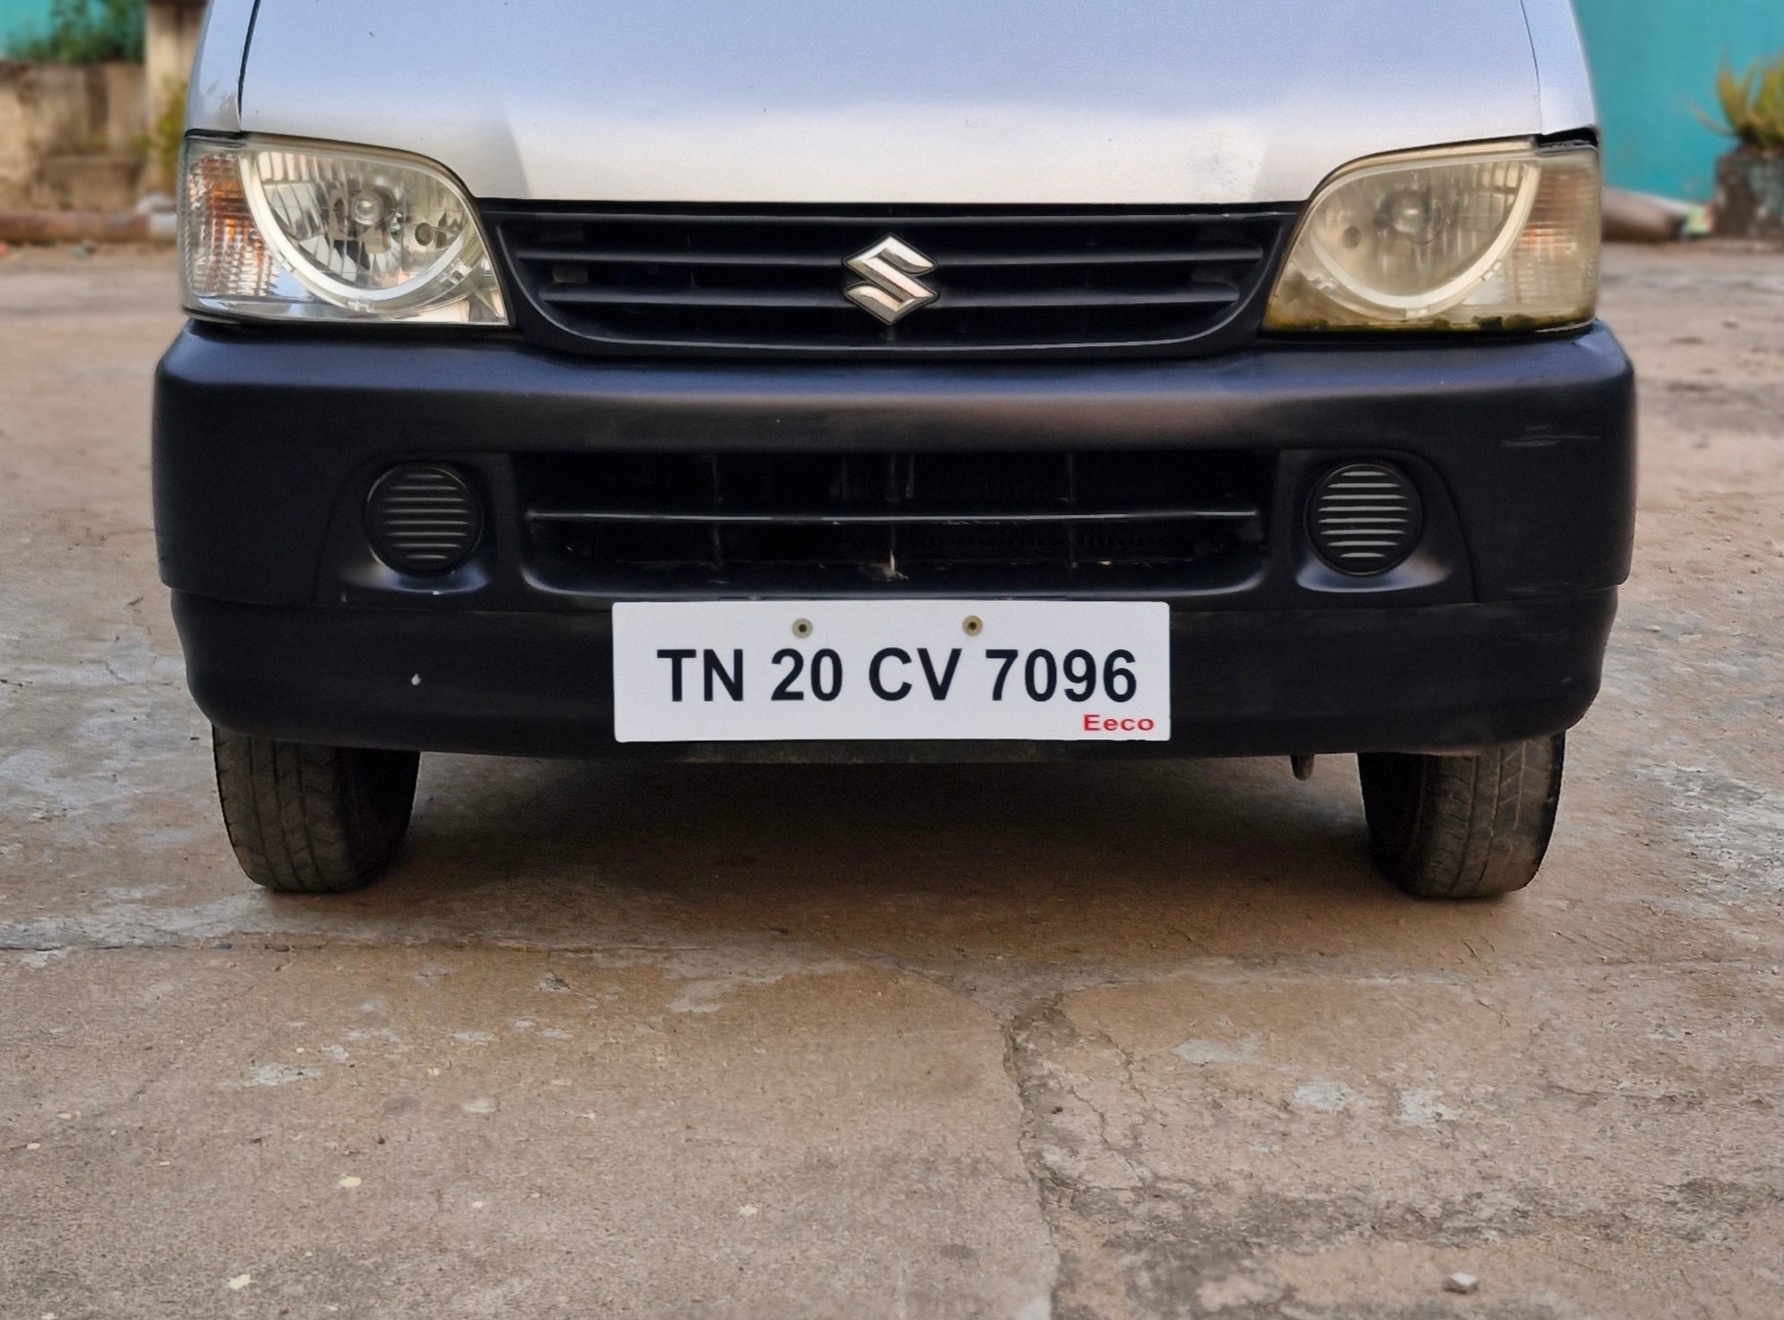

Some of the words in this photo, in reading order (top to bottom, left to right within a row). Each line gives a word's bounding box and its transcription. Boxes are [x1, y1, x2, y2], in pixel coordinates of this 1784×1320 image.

[657, 648, 744, 702] TN
[771, 648, 843, 702] 20
[868, 647, 962, 702] CV
[985, 648, 1137, 703] 7096
[1083, 714, 1155, 732] Eeco
